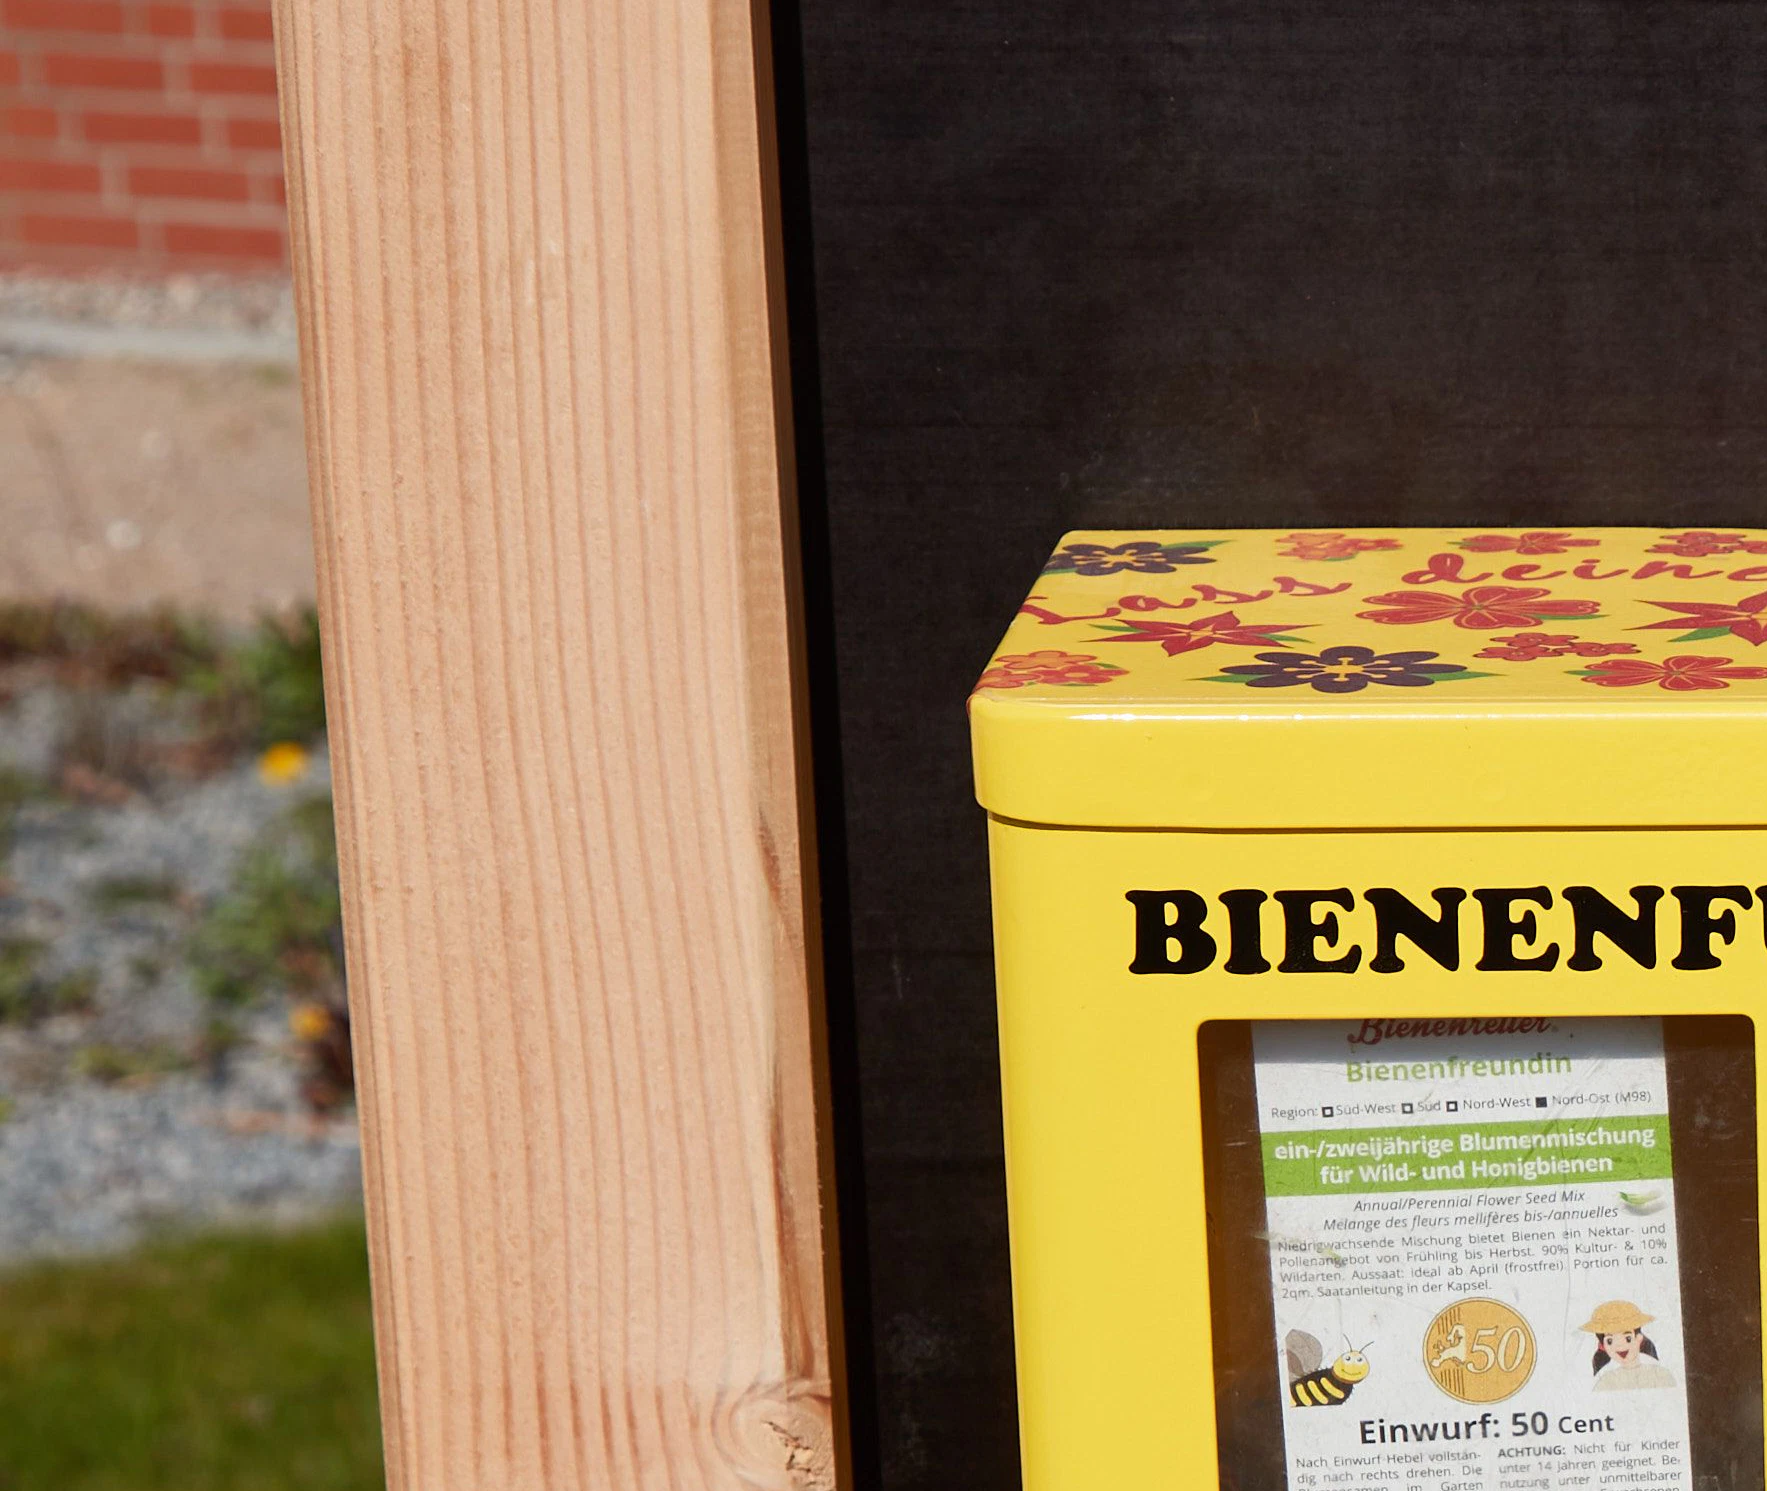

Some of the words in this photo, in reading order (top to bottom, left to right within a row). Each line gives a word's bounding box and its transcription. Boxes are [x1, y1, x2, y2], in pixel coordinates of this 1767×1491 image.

[1017, 575, 1351, 626] Lass
[1347, 1052, 1573, 1084] Bienenfreundin
[1274, 1135, 1454, 1162] ein-/zweijährige
[1459, 1126, 1656, 1153] Blumenmischung
[1319, 1165, 1354, 1185] für
[1358, 1162, 1417, 1183] Wild-
[1421, 1159, 1466, 1181] und
[1471, 1155, 1613, 1181] Honigbienen
[1457, 1327, 1527, 1376] 50
[1359, 1414, 1501, 1445] Einwurf:
[1511, 1410, 1549, 1437] 50
[1559, 1414, 1615, 1435] Cent
